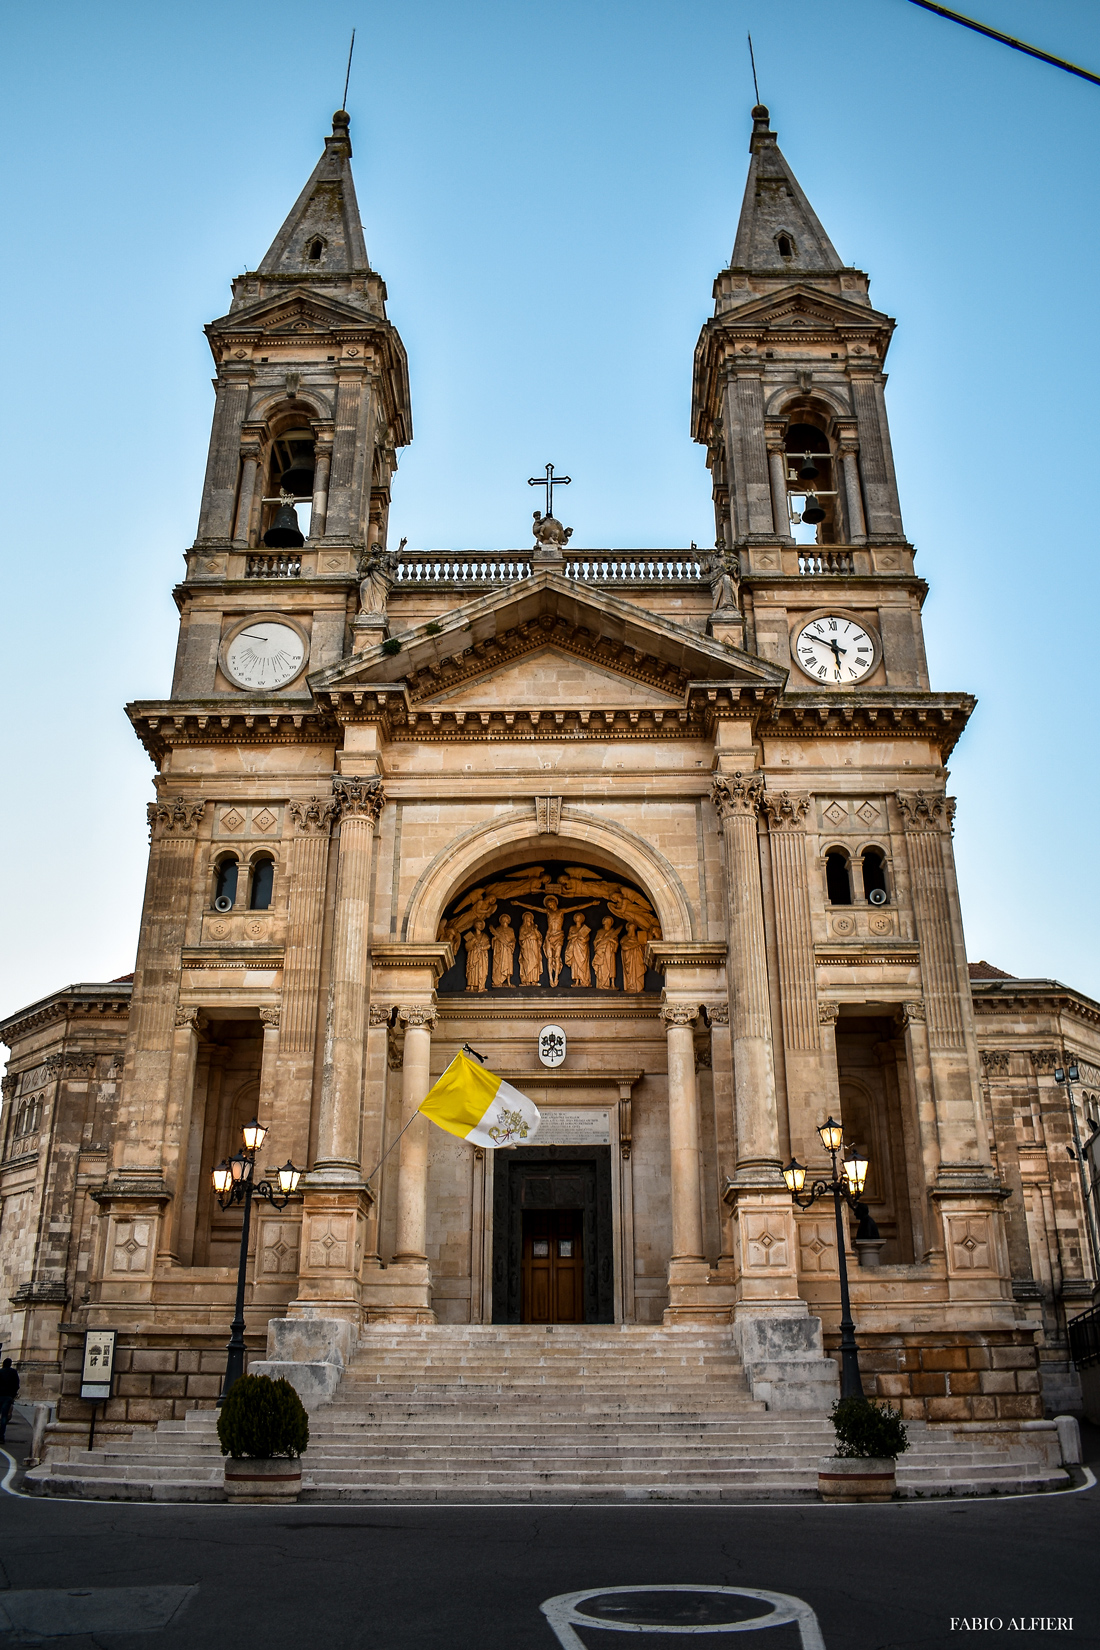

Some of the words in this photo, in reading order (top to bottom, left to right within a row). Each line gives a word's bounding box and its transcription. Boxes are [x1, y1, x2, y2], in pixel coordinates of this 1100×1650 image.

[814, 624, 824, 634] XI
[828, 621, 837, 631] XII
[844, 625, 850, 633] I
[805, 656, 818, 668] VIII
[854, 657, 868, 667] IIII
[817, 665, 828, 677] VII
[834, 670, 842, 679] VI
[848, 667, 857, 676] V
